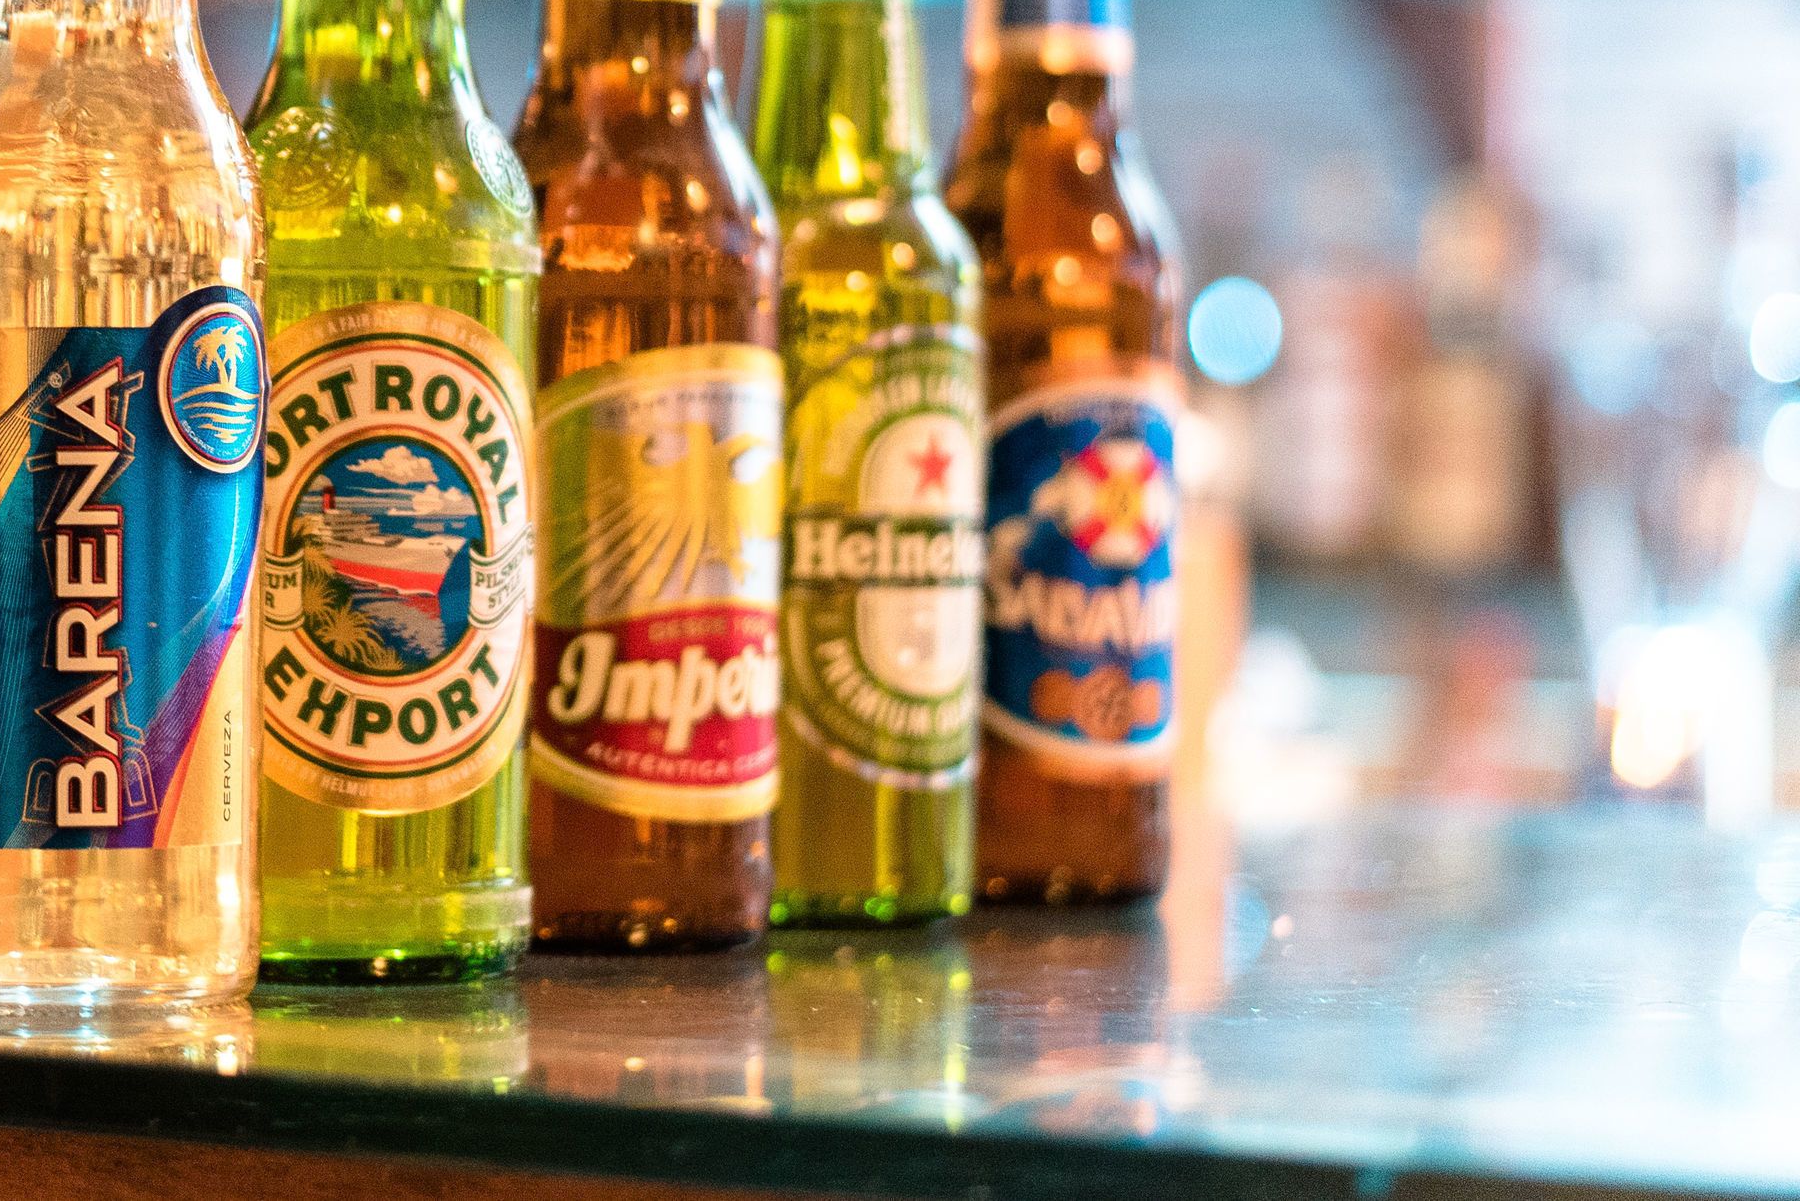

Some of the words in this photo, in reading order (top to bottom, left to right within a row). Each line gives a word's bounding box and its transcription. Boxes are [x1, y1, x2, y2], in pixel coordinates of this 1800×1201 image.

[265, 366, 360, 480] ORT
[372, 361, 524, 526] ROYAL
[55, 355, 124, 829] BARENA
[221, 708, 233, 823] CERVEZA
[264, 642, 503, 749] EXPORT
